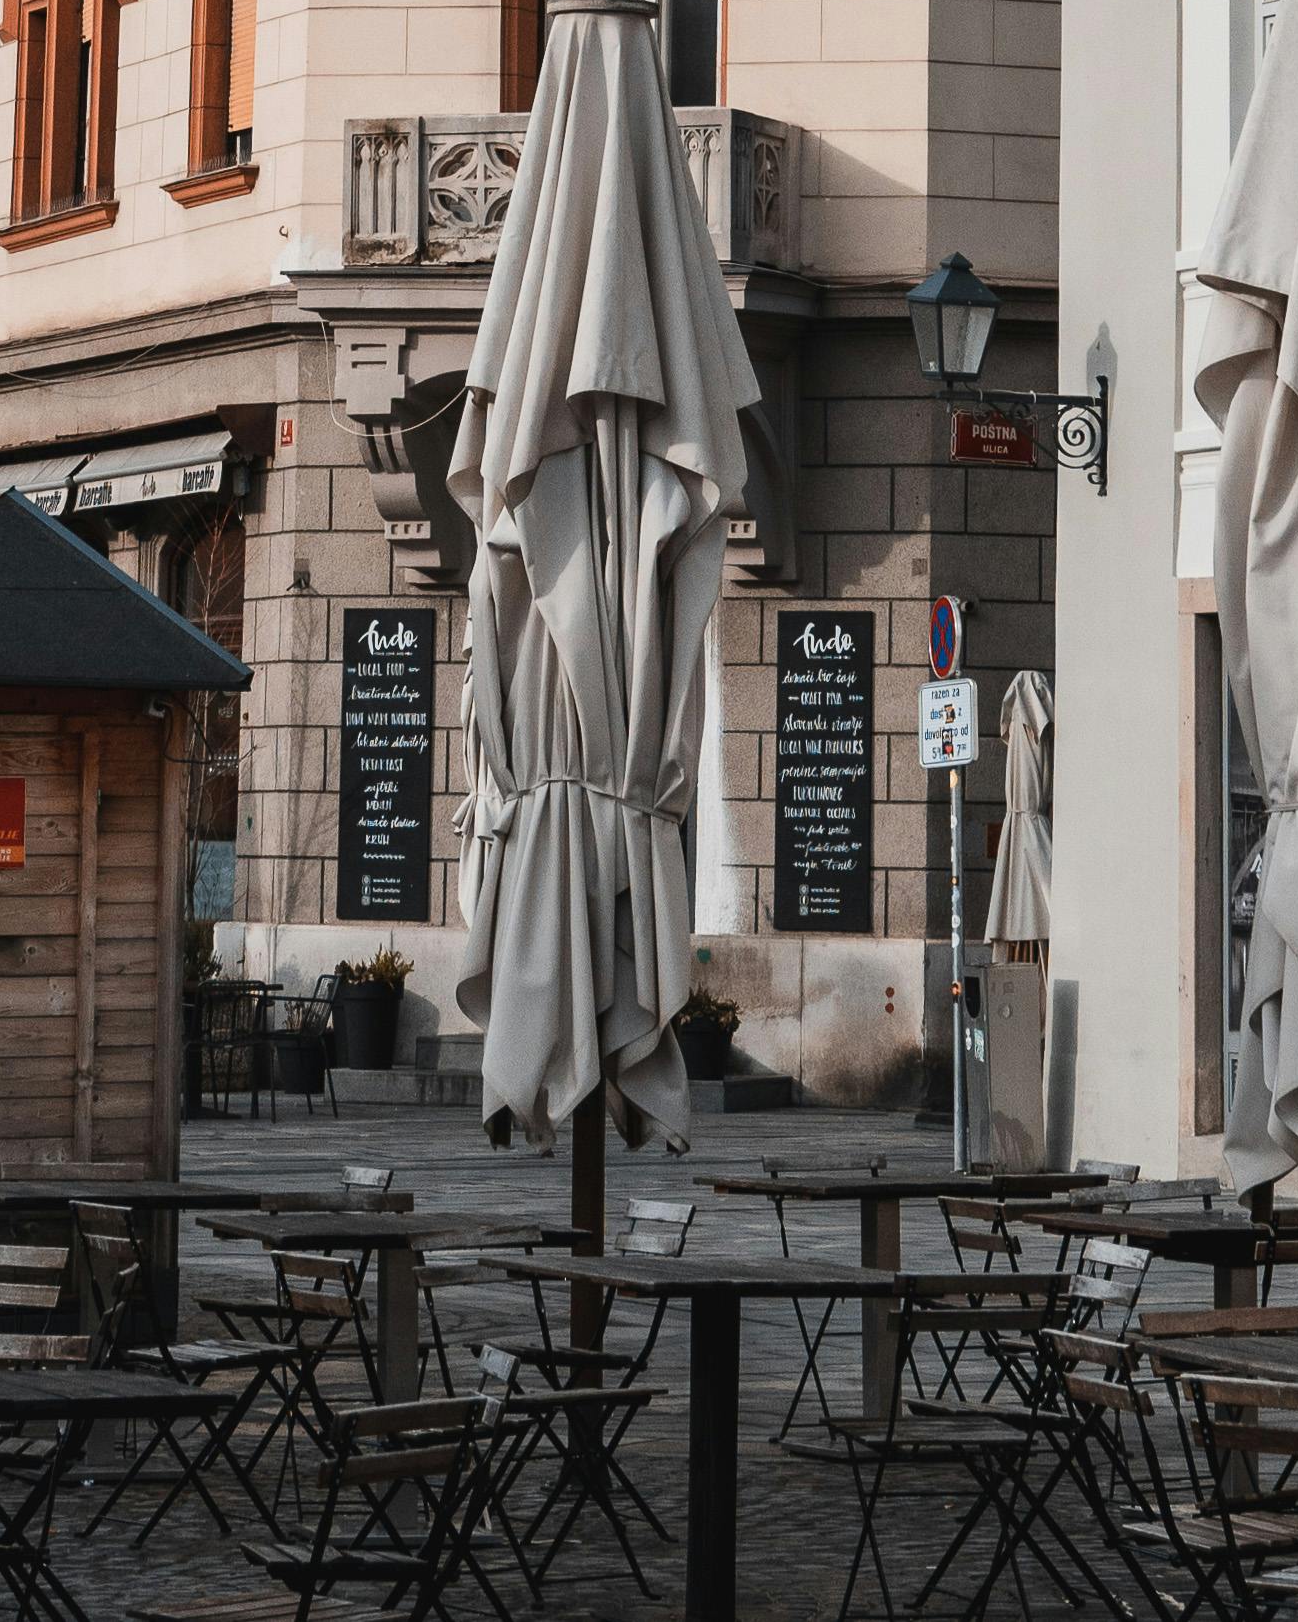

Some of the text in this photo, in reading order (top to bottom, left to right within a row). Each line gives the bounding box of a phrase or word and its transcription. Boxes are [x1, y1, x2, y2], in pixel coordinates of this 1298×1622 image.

[972, 423, 1017, 441] POŠTNA
[983, 444, 1008, 454] ULICA
[357, 662, 405, 676] LOCAL FOOD
[931, 687, 960, 699] razen za
[961, 723, 968, 735] od
[779, 739, 802, 755] LOCAL
